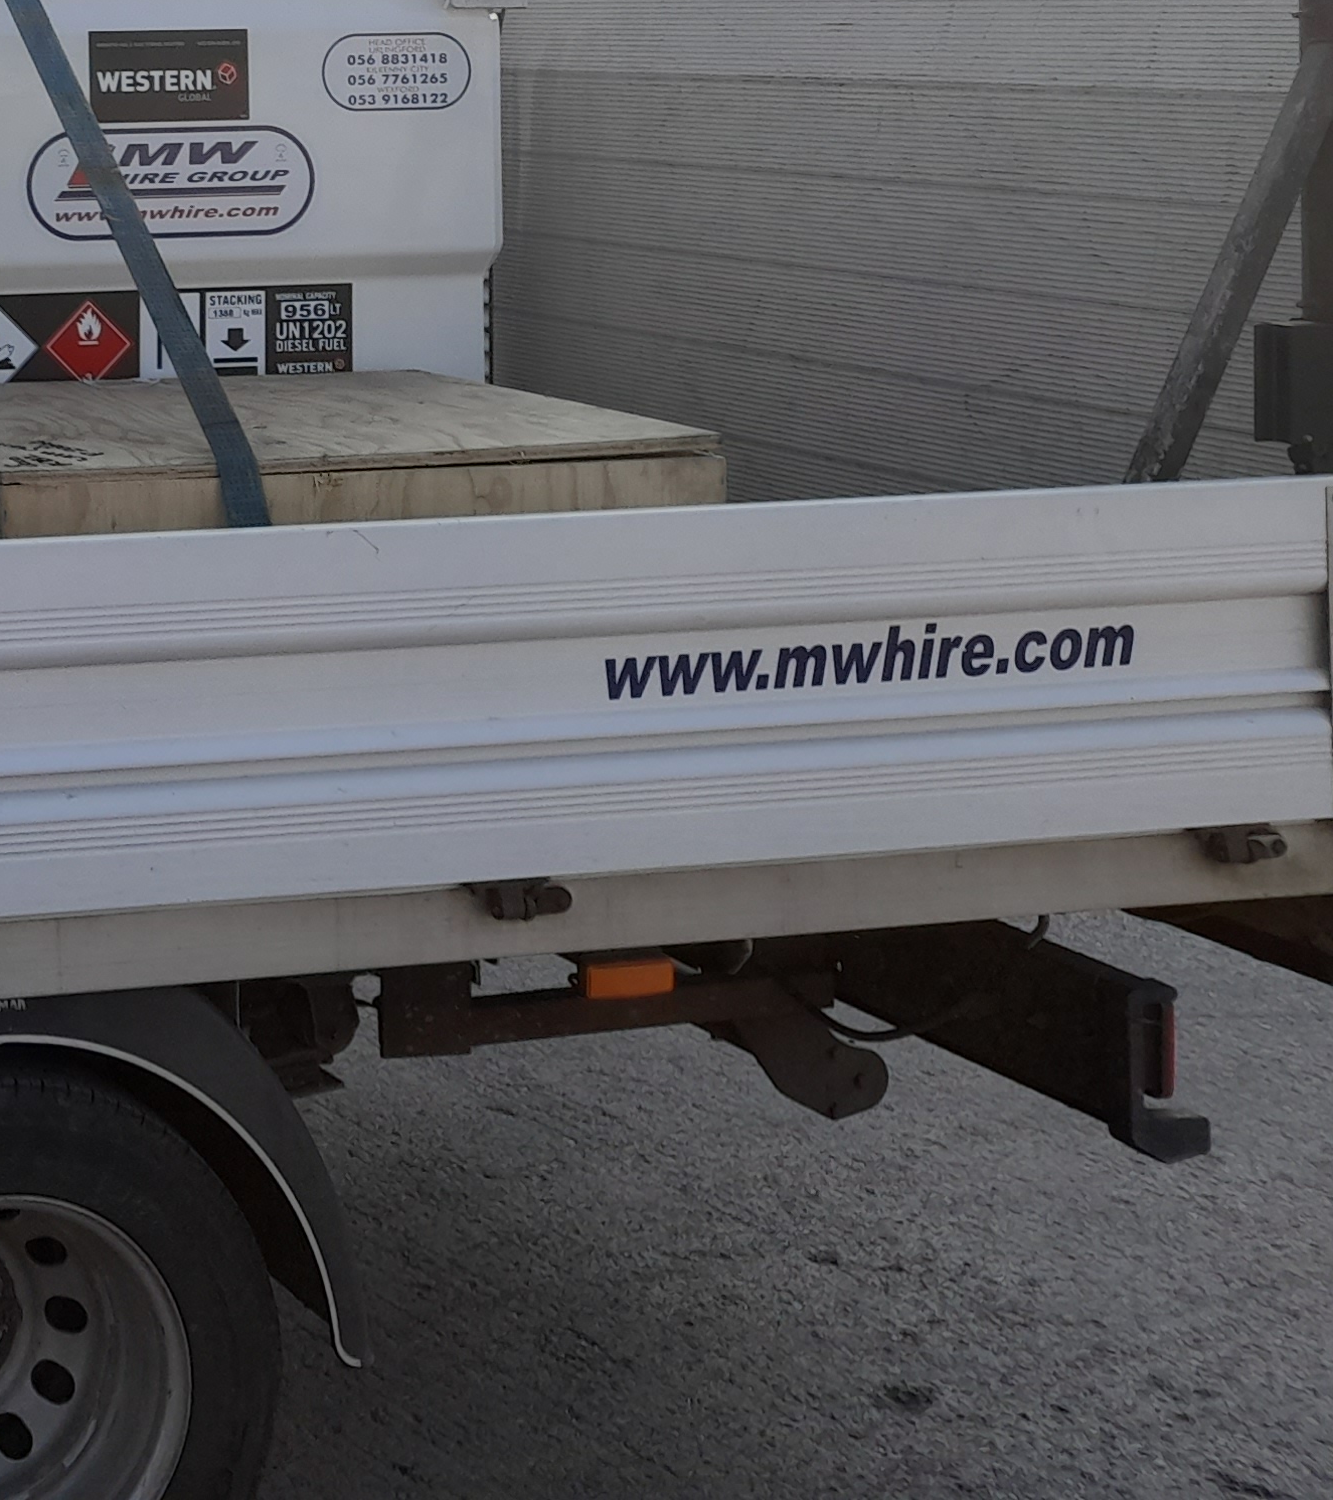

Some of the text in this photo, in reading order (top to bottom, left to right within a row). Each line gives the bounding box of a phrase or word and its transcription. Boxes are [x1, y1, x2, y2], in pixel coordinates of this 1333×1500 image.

[347, 52, 448, 66] 056 8831418
[96, 69, 213, 92] WESTERN
[347, 72, 448, 86] 056 7761265
[178, 92, 212, 102] GLOBAL
[348, 92, 449, 106] 053 9168122
[119, 141, 259, 166] MW
[186, 169, 290, 183] GROUP
[209, 294, 263, 307] STACKING
[284, 302, 342, 318] 956 LT
[275, 320, 347, 339] UN1202
[276, 338, 347, 352] DIESEL FUEL
[277, 362, 333, 374] WESTERN
[604, 623, 1135, 700] www.mwhire.com
